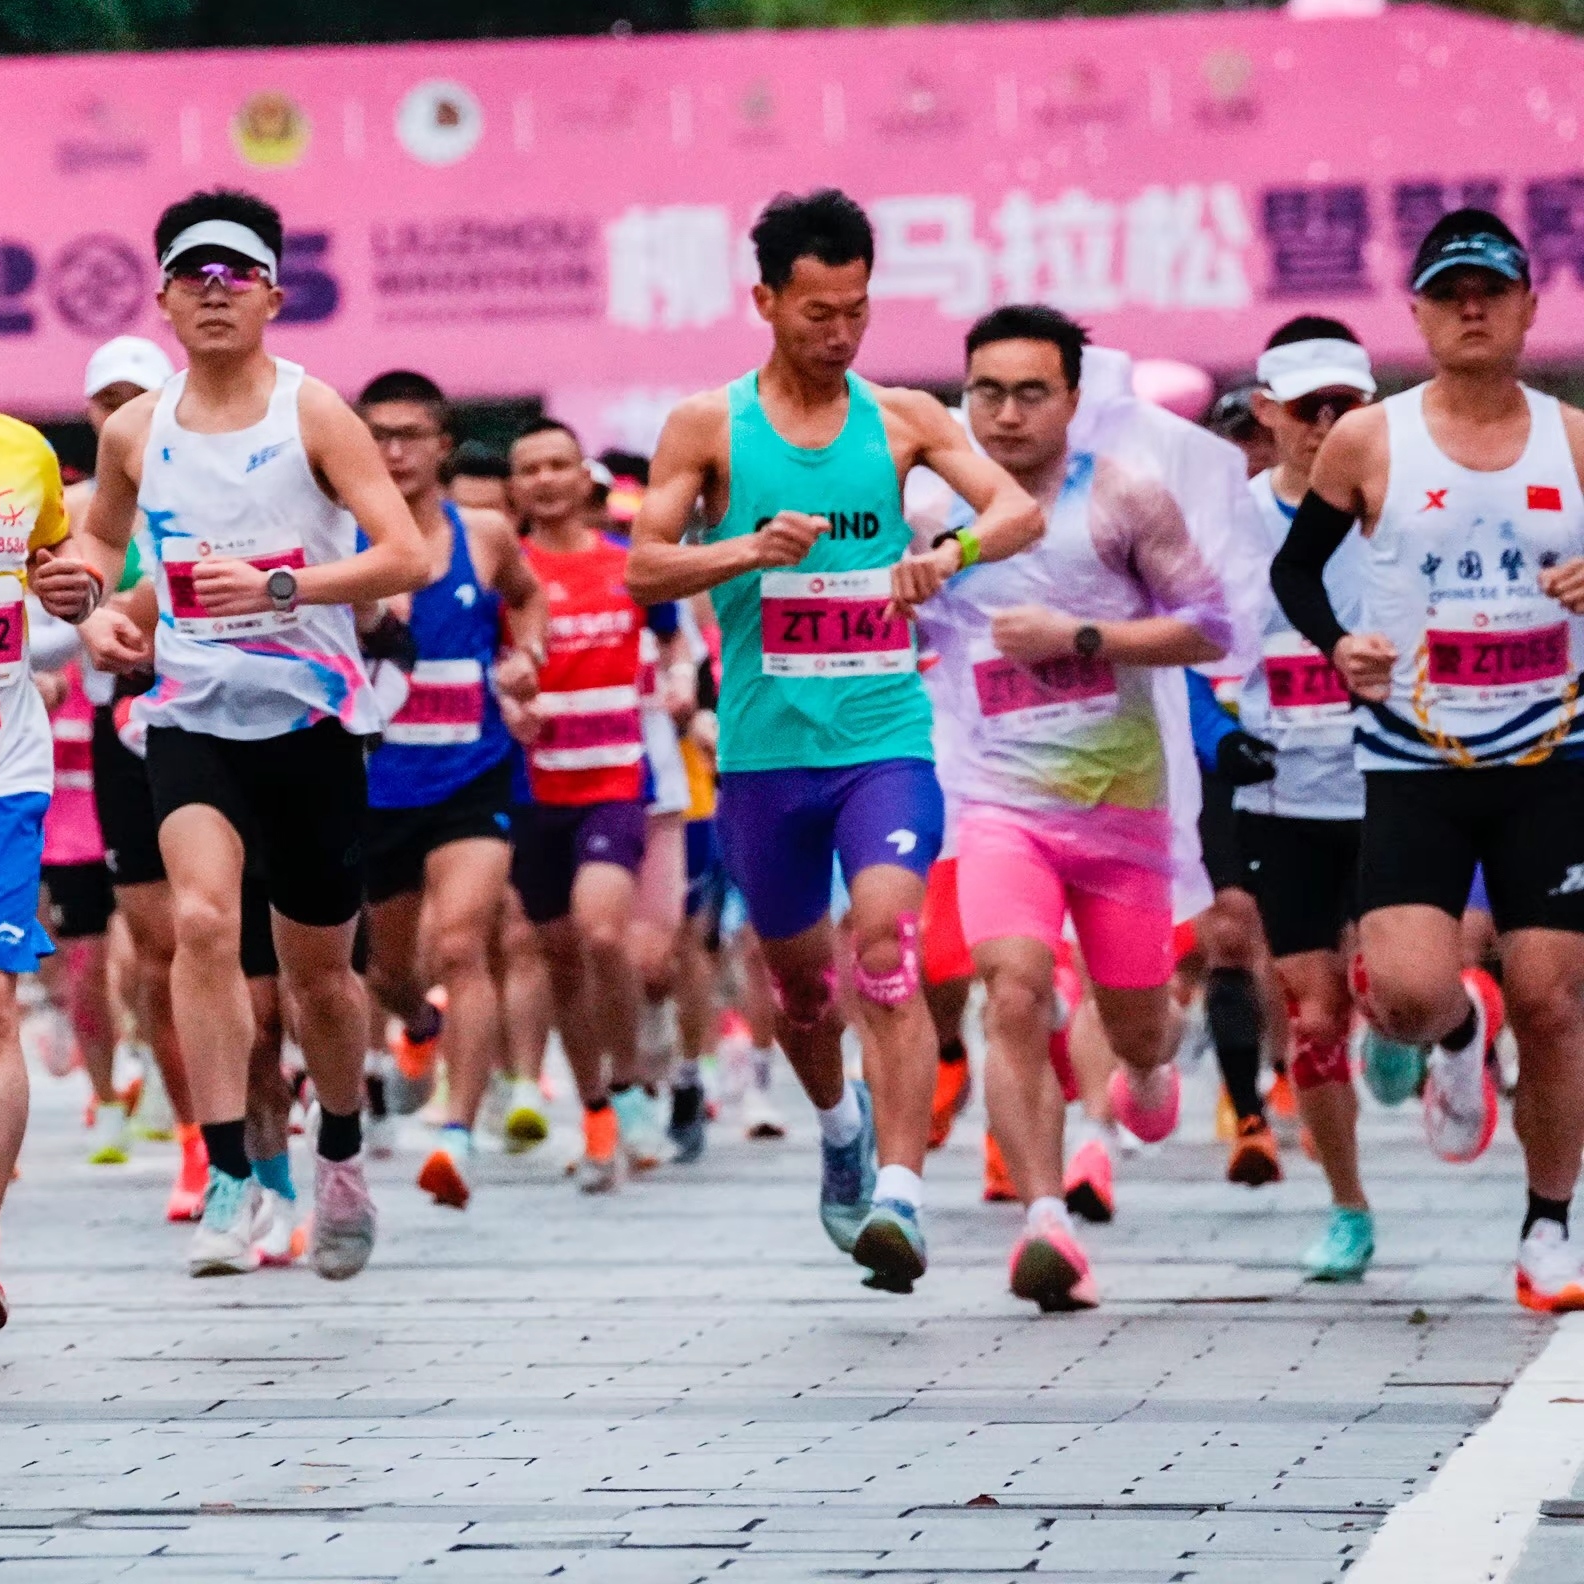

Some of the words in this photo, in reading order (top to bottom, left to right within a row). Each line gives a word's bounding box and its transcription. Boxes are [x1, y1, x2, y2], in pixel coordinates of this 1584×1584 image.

[607, 183, 1252, 328] 柳马拉松
[783, 608, 828, 643] ZT
